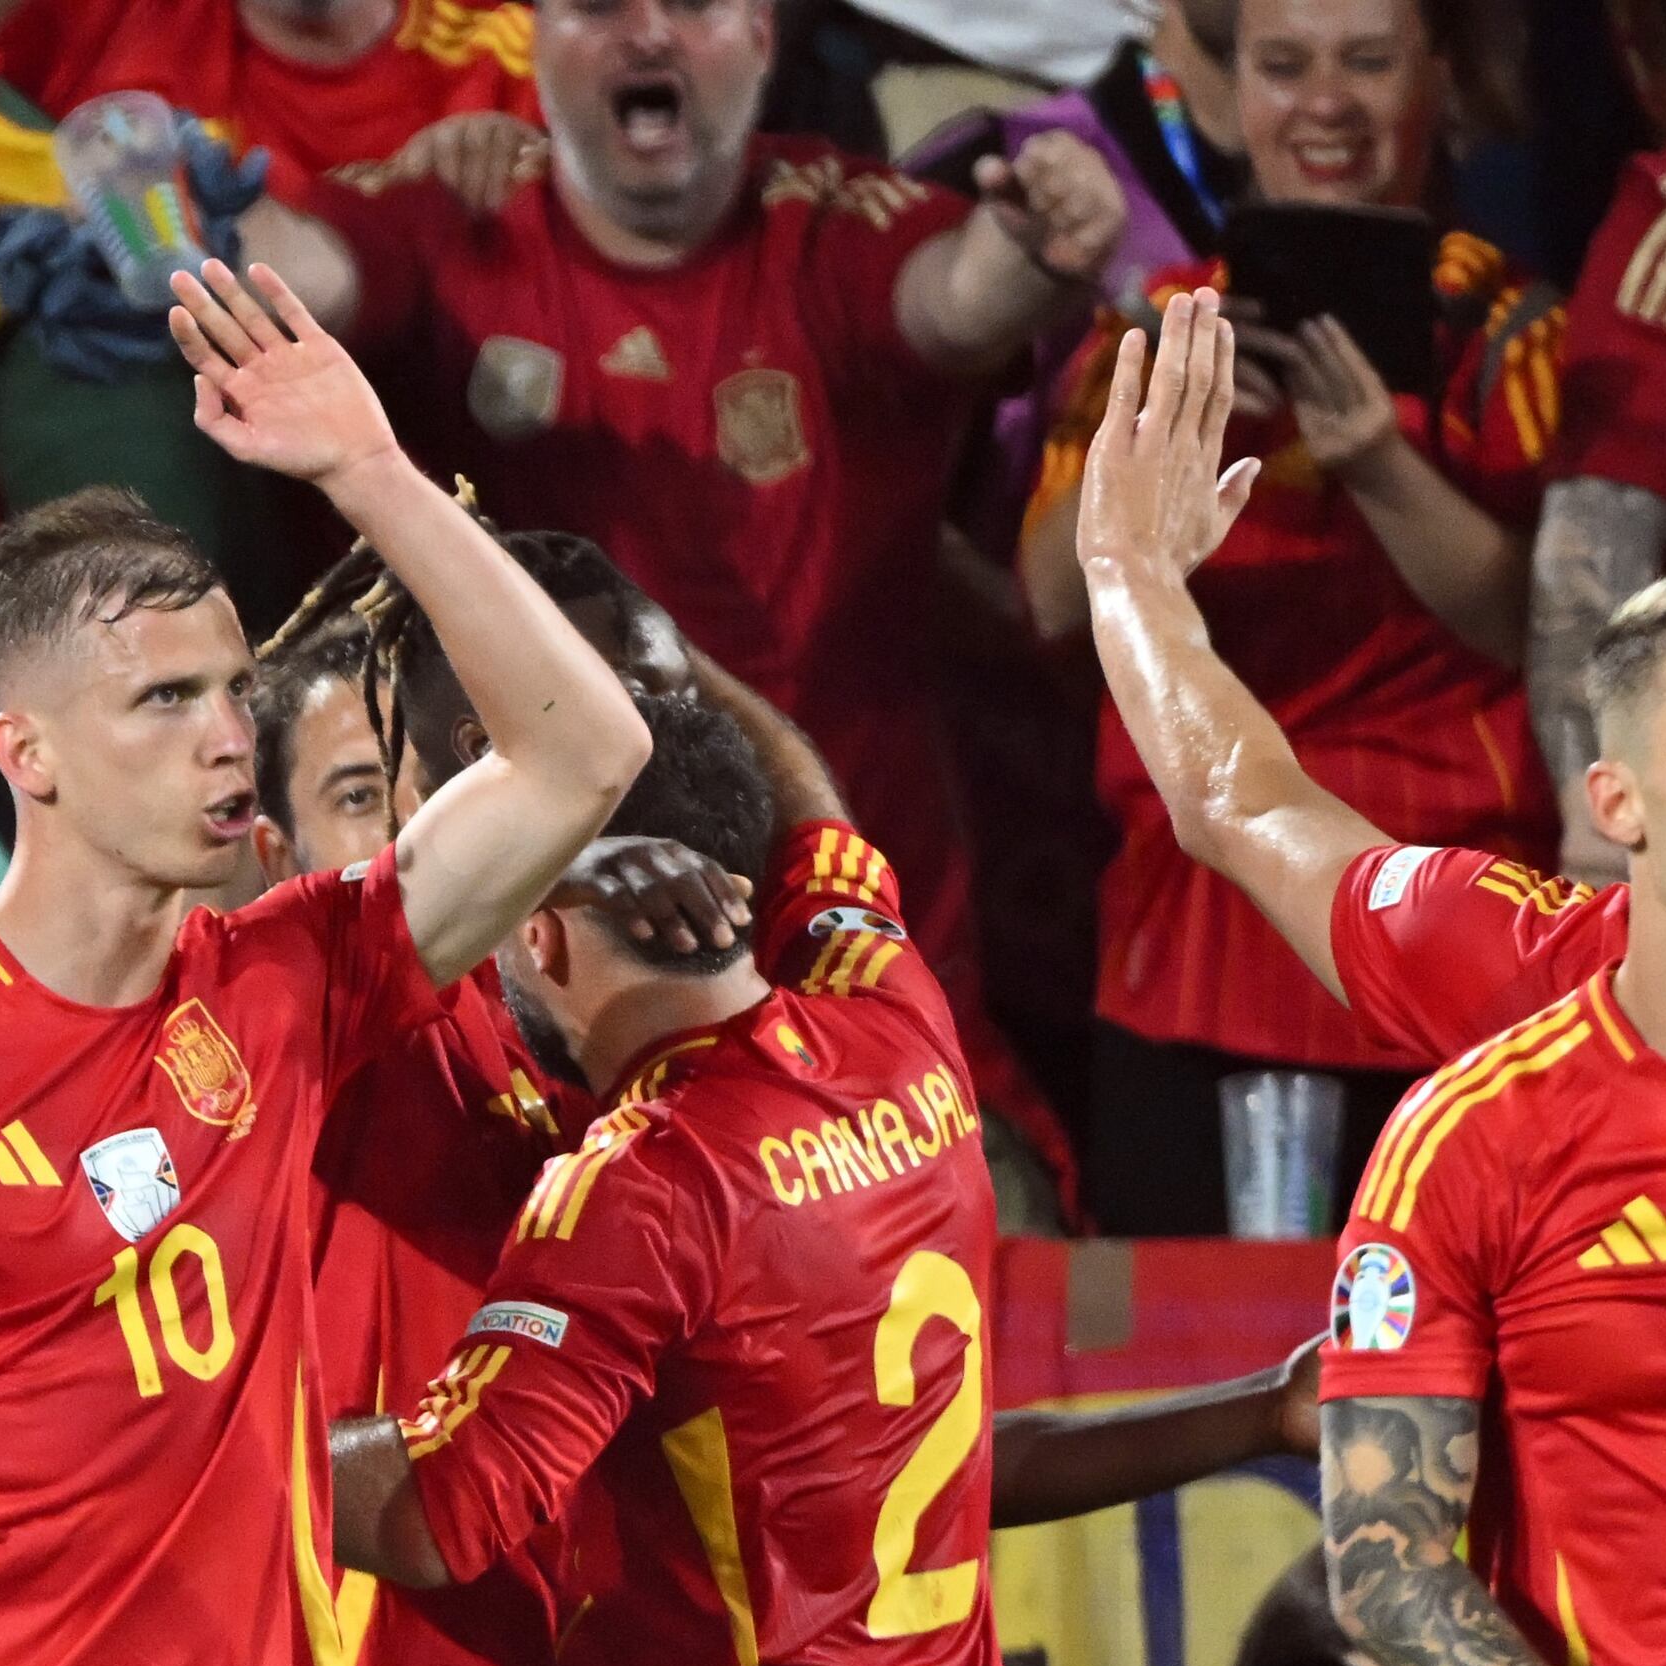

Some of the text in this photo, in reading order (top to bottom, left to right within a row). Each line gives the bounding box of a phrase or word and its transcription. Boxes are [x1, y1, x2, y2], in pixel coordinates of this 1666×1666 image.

[759, 1064, 978, 1206] CARVAJAL
[93, 1222, 236, 1398] 10
[867, 1249, 982, 1638] 2
